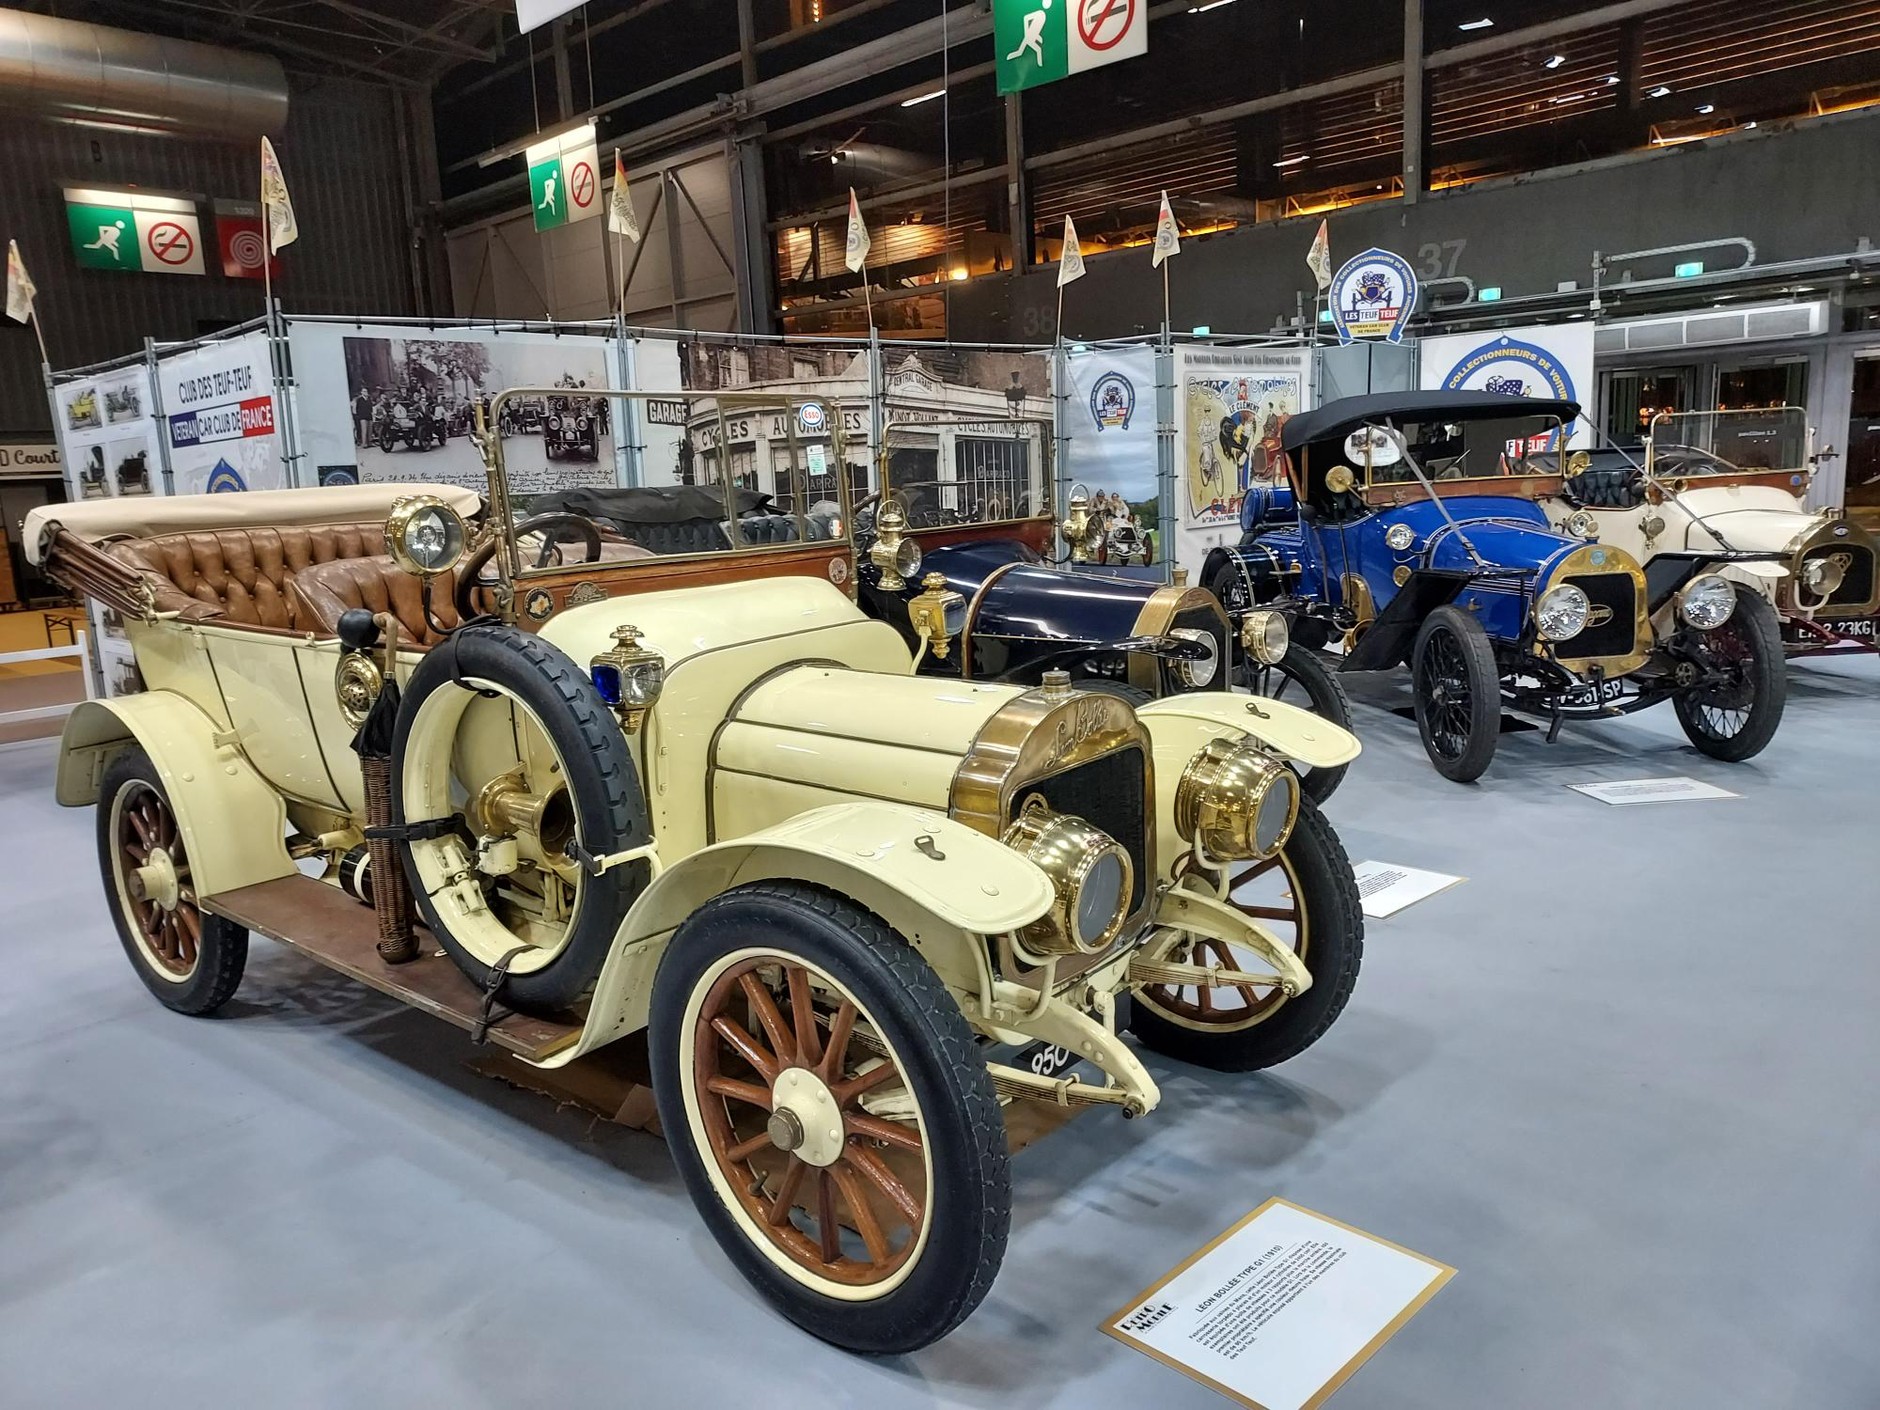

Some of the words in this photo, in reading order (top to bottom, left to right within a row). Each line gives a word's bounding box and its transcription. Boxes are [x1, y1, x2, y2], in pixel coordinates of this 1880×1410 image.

[1418, 239, 1467, 280] 37
[1024, 306, 1056, 337] 38
[1345, 312, 1358, 320] LES
[1360, 310, 1379, 319] TEUF
[1381, 309, 1400, 318] TEUF
[179, 380, 198, 404] CLUB
[197, 376, 213, 399] DES
[213, 365, 252, 396] TEUF-TEUF
[894, 372, 914, 386] CENTRAL
[916, 373, 932, 391] GARAGE
[1449, 349, 1537, 389] COLLECTIONNEURS
[1538, 357, 1552, 371] DE
[1549, 369, 1568, 400] VOITUR
[649, 402, 687, 424] GARAGE
[1229, 405, 1236, 413] LE
[171, 420, 199, 441] VETERAN
[199, 418, 212, 437] CAR
[213, 412, 231, 434] CLUB
[232, 411, 242, 431] DE
[241, 405, 272, 430] FRANCE
[701, 420, 749, 447] CYES
[14, 448, 60, 465] Court
[1196, 1297, 1216, 1312] LÉON
[1213, 1278, 1241, 1298] BOLLÉE
[1237, 1265, 1257, 1278] TYPE
[1262, 1245, 1283, 1260] (1910)
[1235, 1300, 1248, 1311] places
[1261, 1298, 1270, 1307] pour
